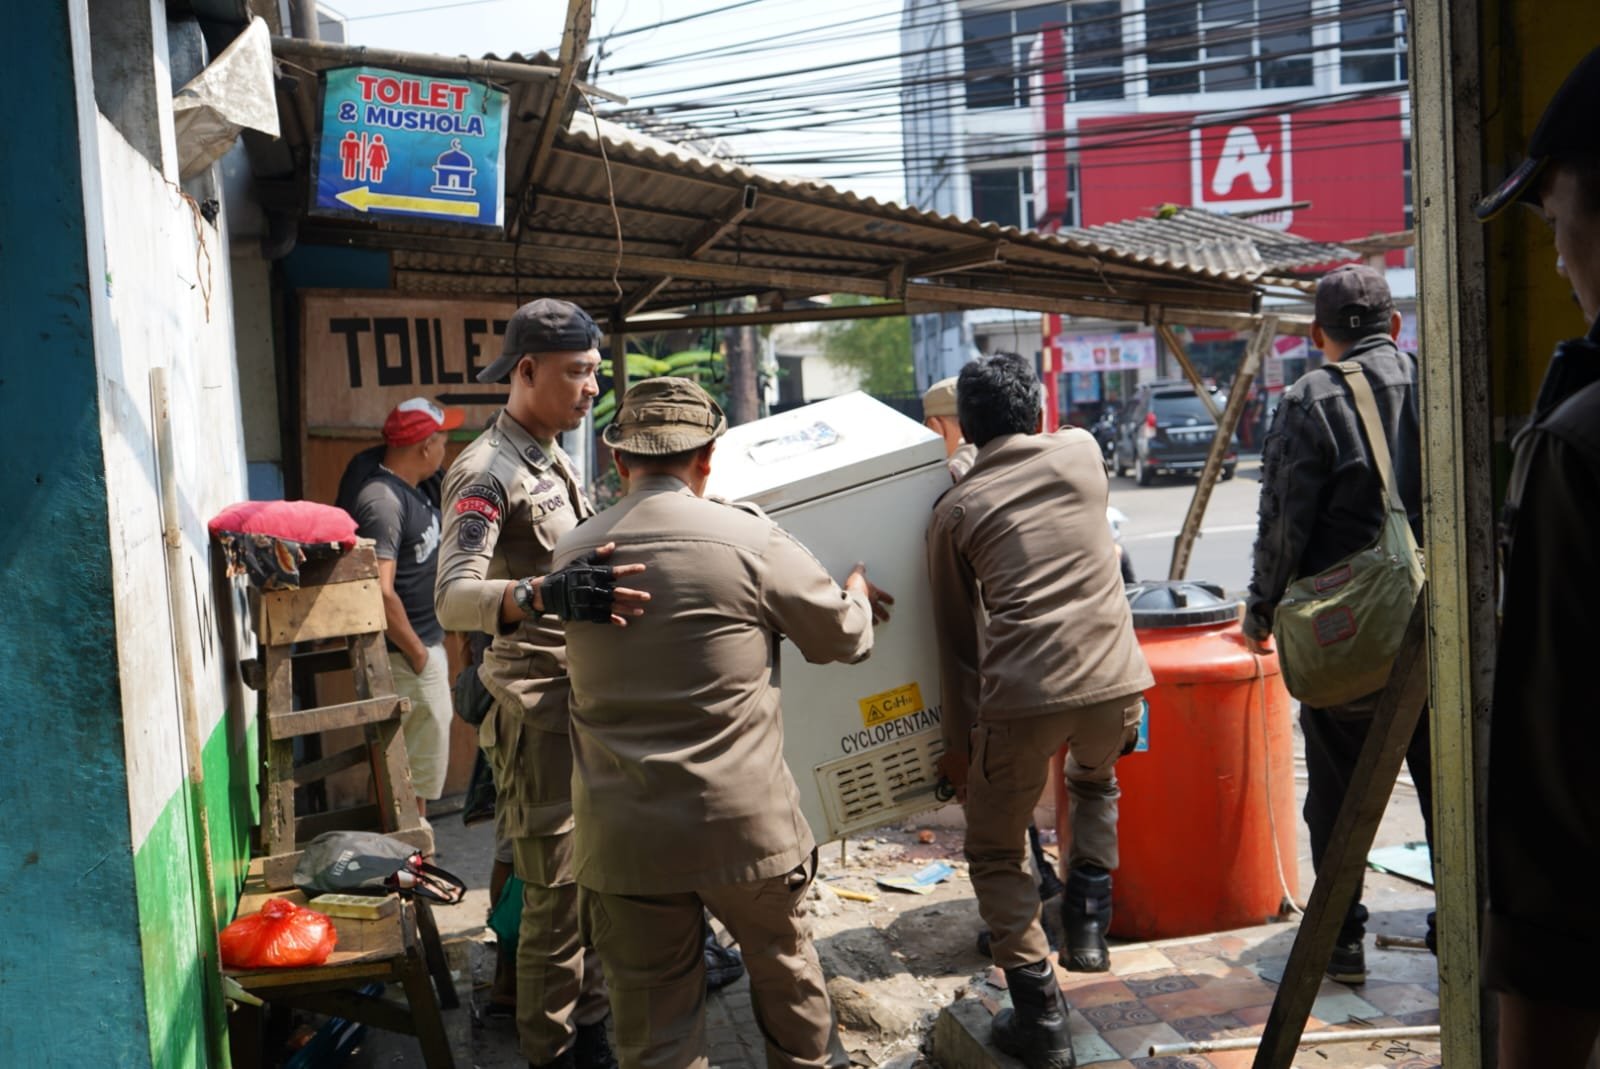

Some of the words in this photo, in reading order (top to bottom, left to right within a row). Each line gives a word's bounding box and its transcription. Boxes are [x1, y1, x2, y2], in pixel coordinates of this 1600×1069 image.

[357, 75, 469, 111] TOILET
[340, 103, 357, 121] &
[367, 106, 484, 137] MUSHOLA
[841, 705, 944, 754] CYCLOPENTAN
